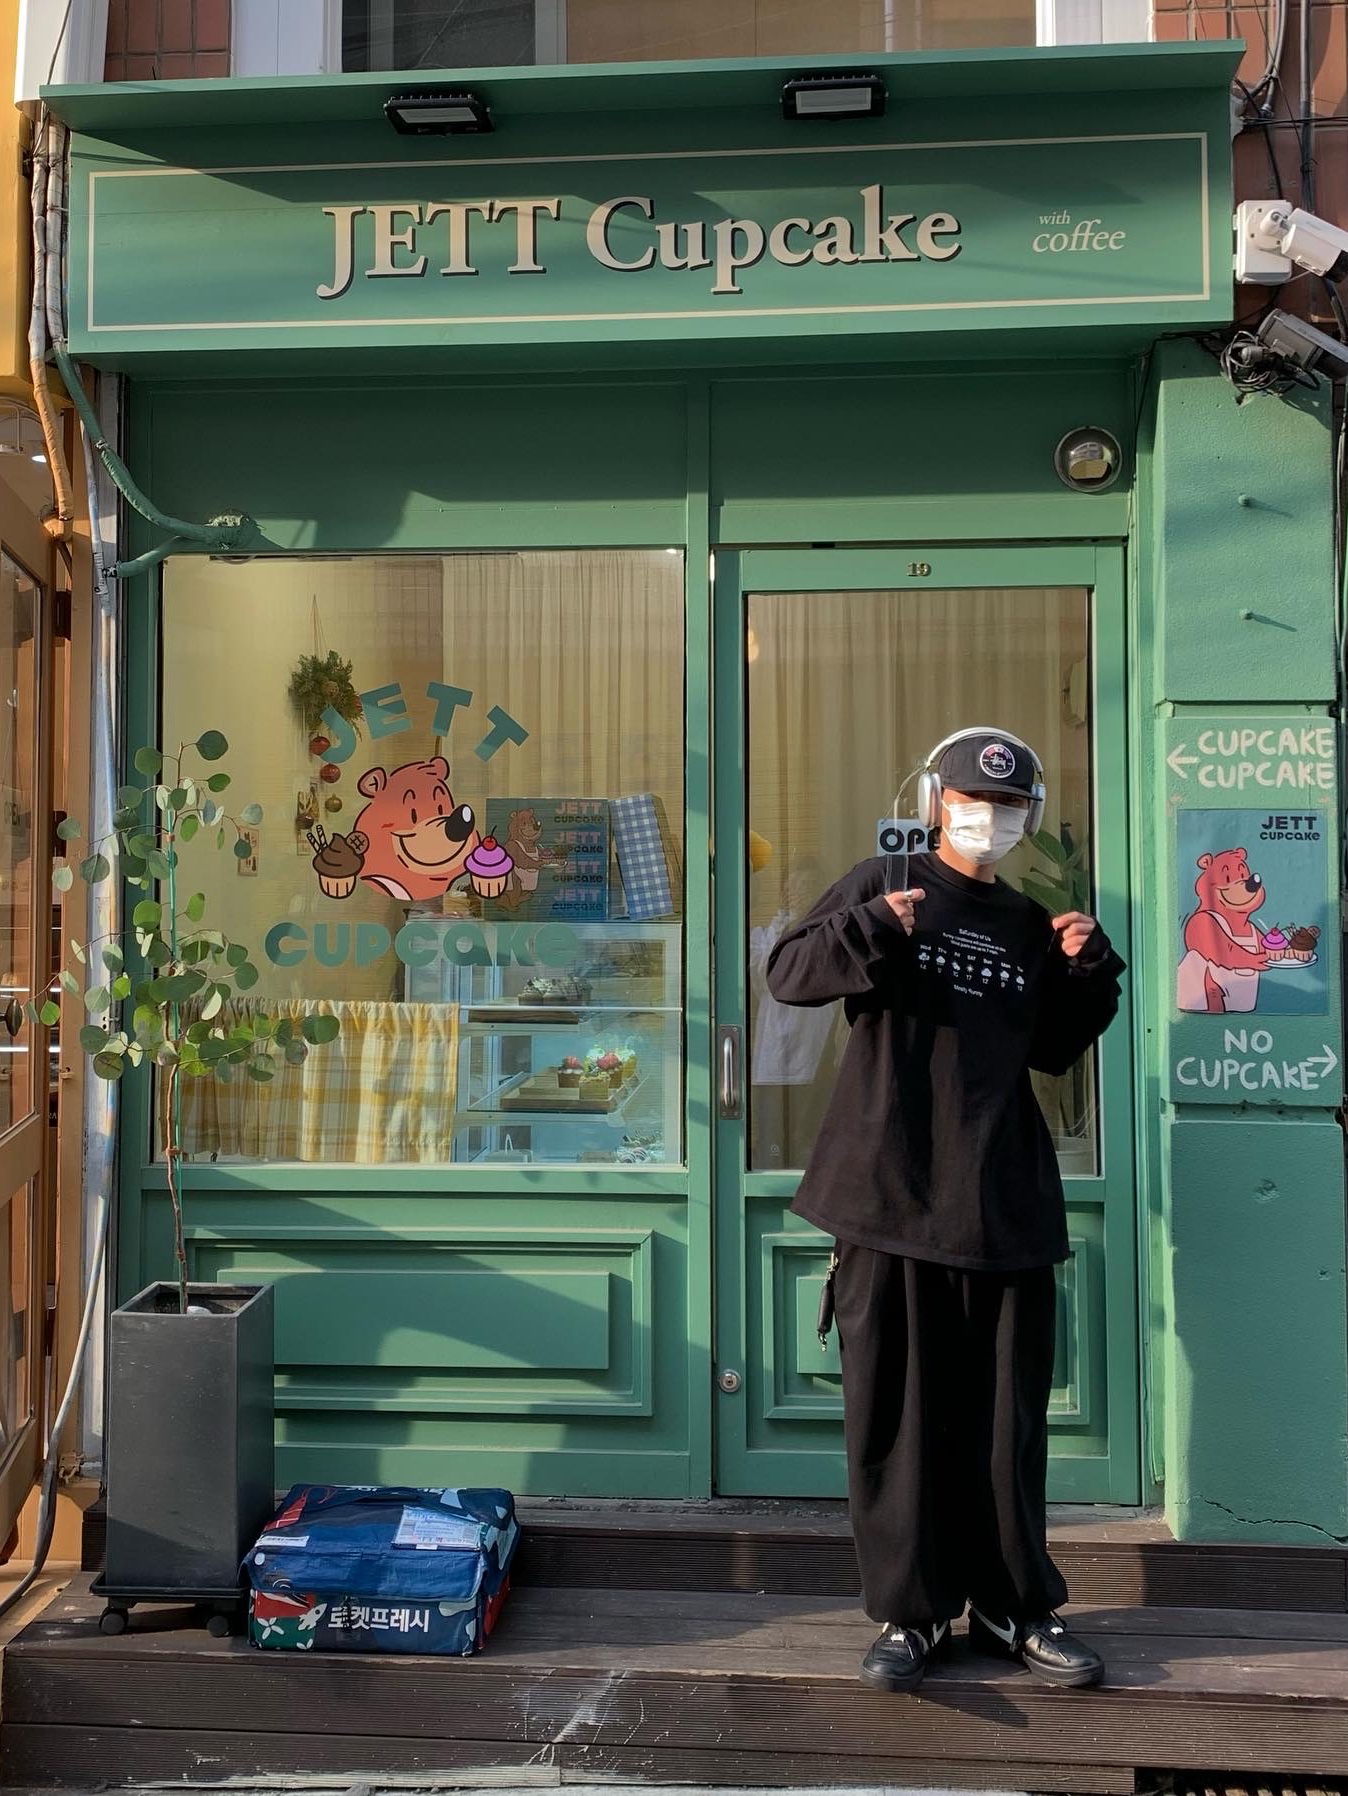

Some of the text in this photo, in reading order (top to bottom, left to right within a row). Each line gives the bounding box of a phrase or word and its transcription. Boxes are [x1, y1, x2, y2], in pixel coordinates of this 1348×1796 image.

[1039, 210, 1071, 224] with
[316, 184, 962, 300] JETT Cupcake
[1032, 219, 1126, 253] coffee
[320, 681, 530, 763] JETT
[1198, 728, 1335, 759] CUPCAKE
[1198, 761, 1335, 791] CUPCAKE
[555, 800, 602, 815] JETT
[1261, 815, 1318, 830] JETT
[880, 828, 941, 853] OPE
[554, 888, 601, 902] JETT
[1223, 1029, 1274, 1055] NO
[1176, 1056, 1320, 1091] CUPCAKE
[328, 1606, 430, 1633] 로켓프레시
